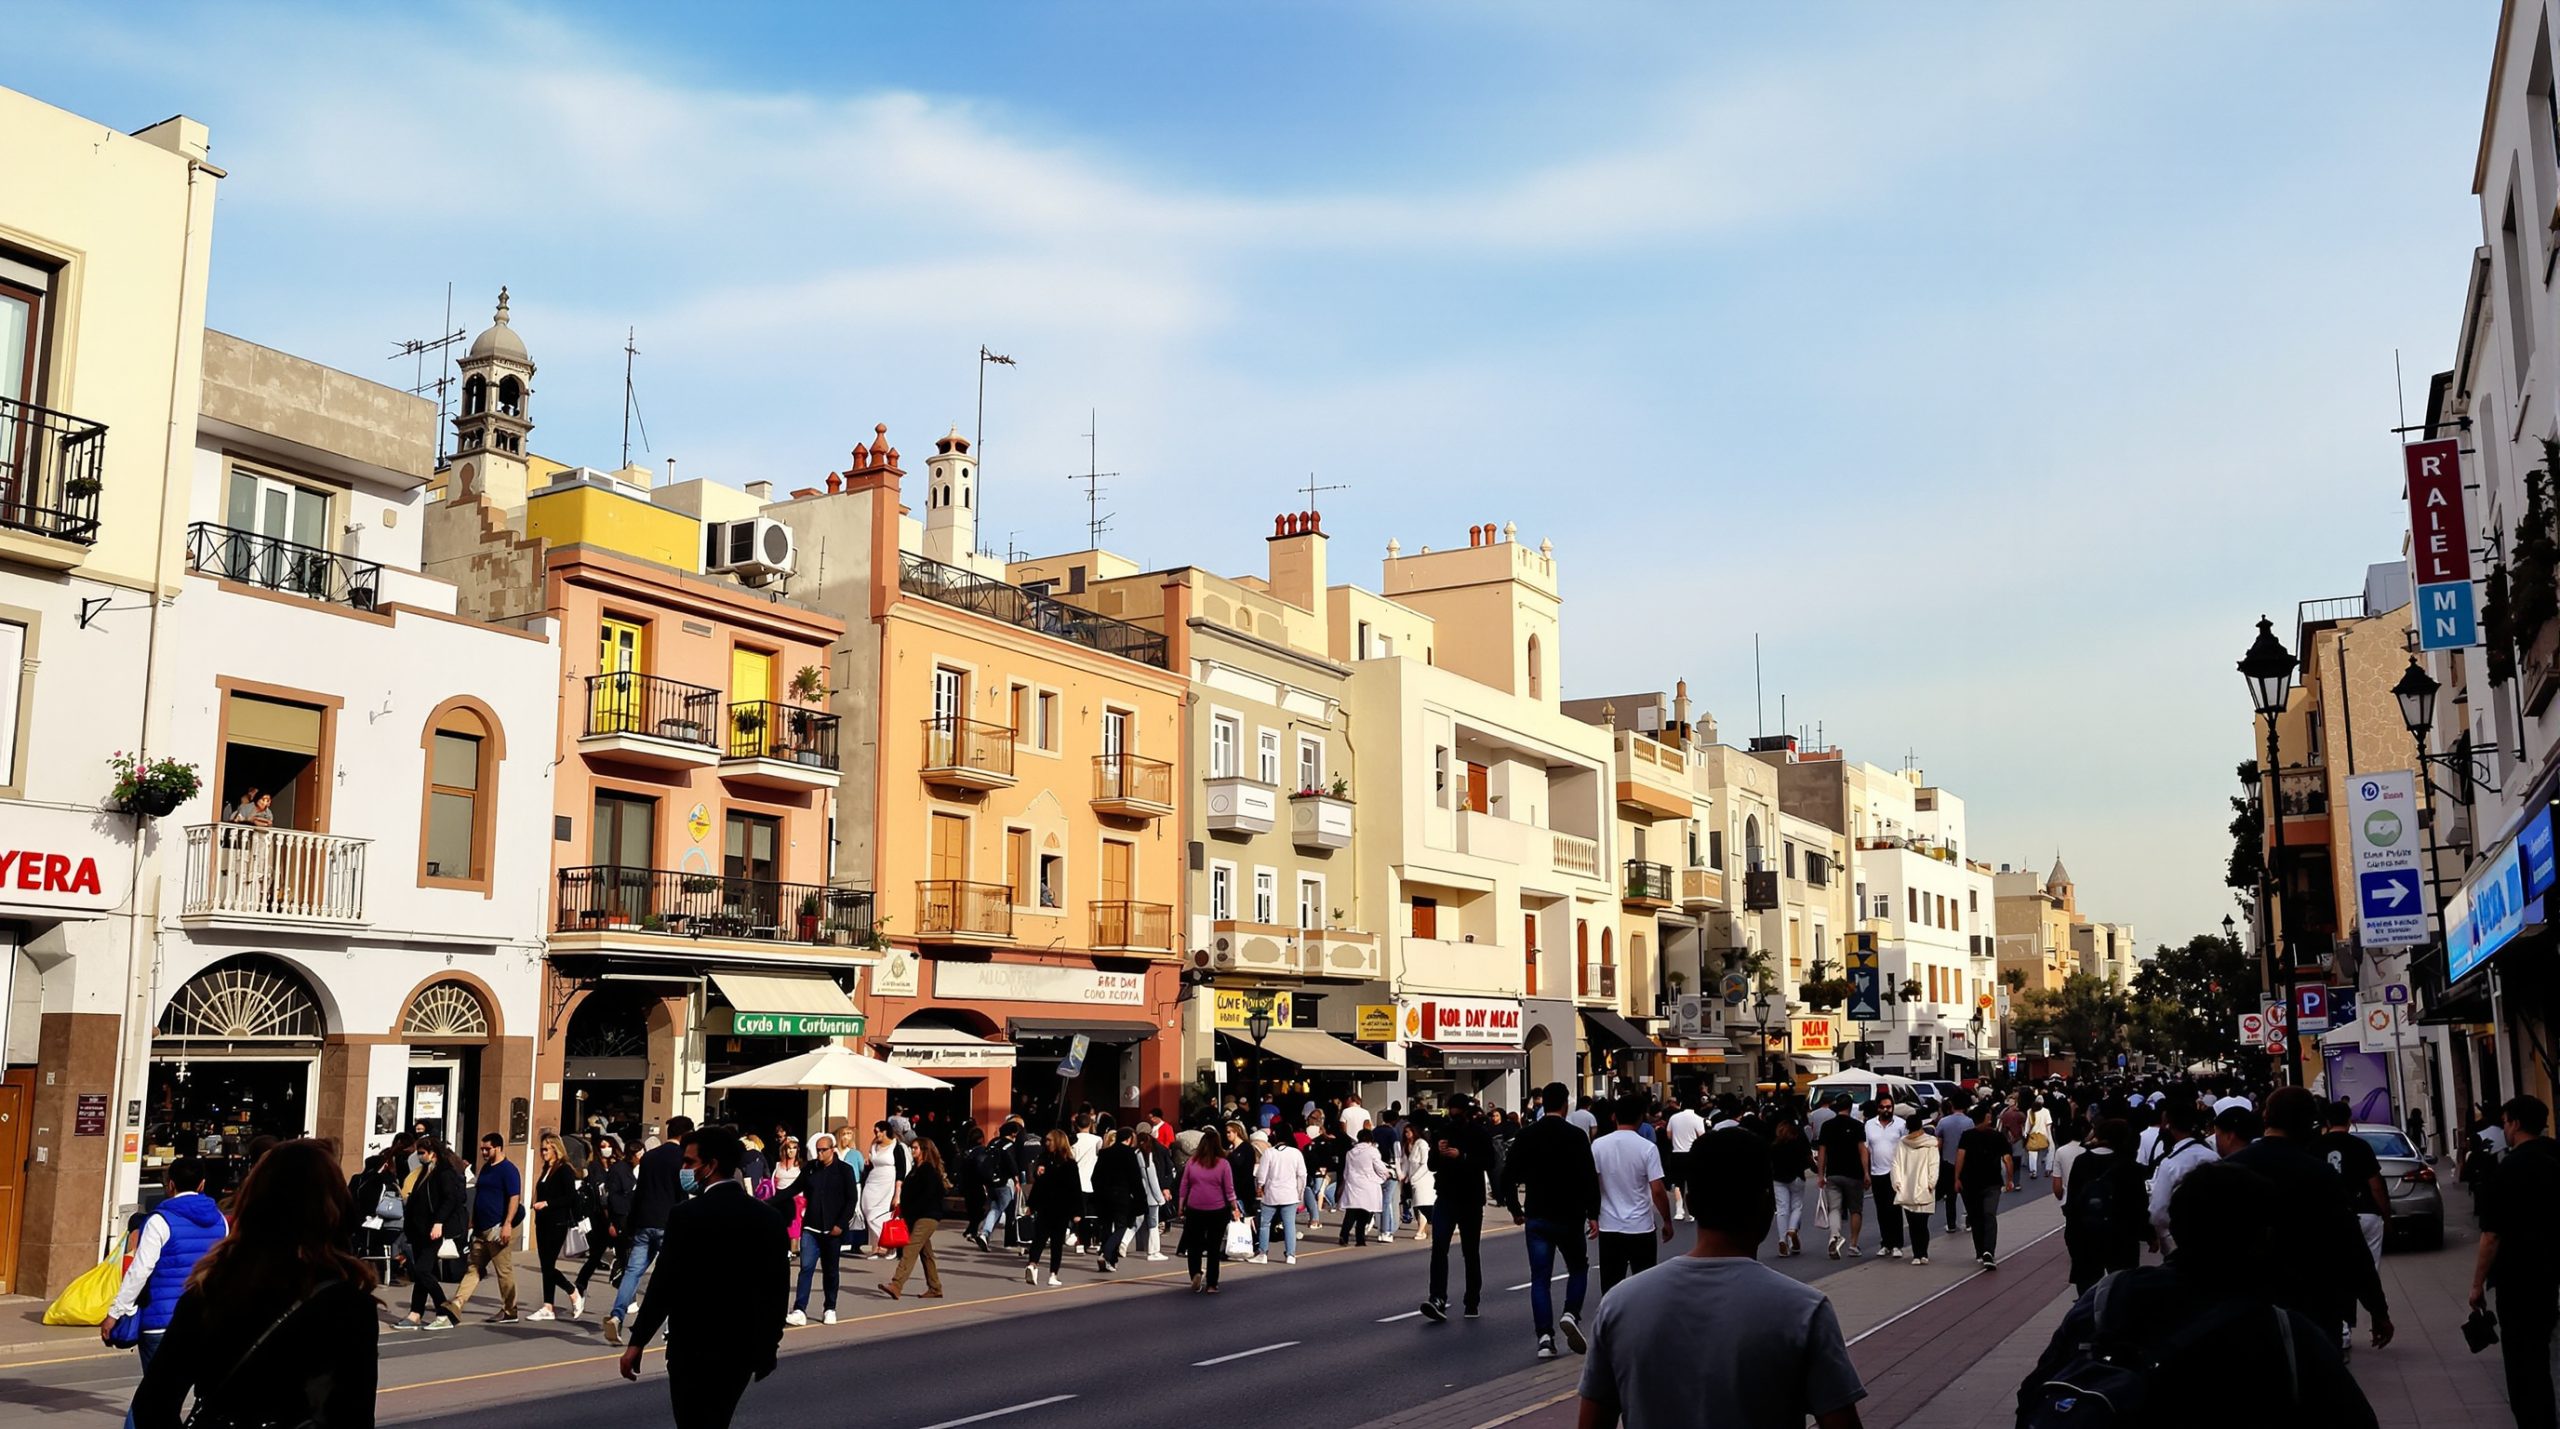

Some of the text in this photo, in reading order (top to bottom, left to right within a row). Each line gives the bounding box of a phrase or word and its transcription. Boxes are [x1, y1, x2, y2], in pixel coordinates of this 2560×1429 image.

[0, 850, 101, 895] YERA
[2303, 992, 2321, 1014] P
[1465, 1009, 1487, 1028] DAY
